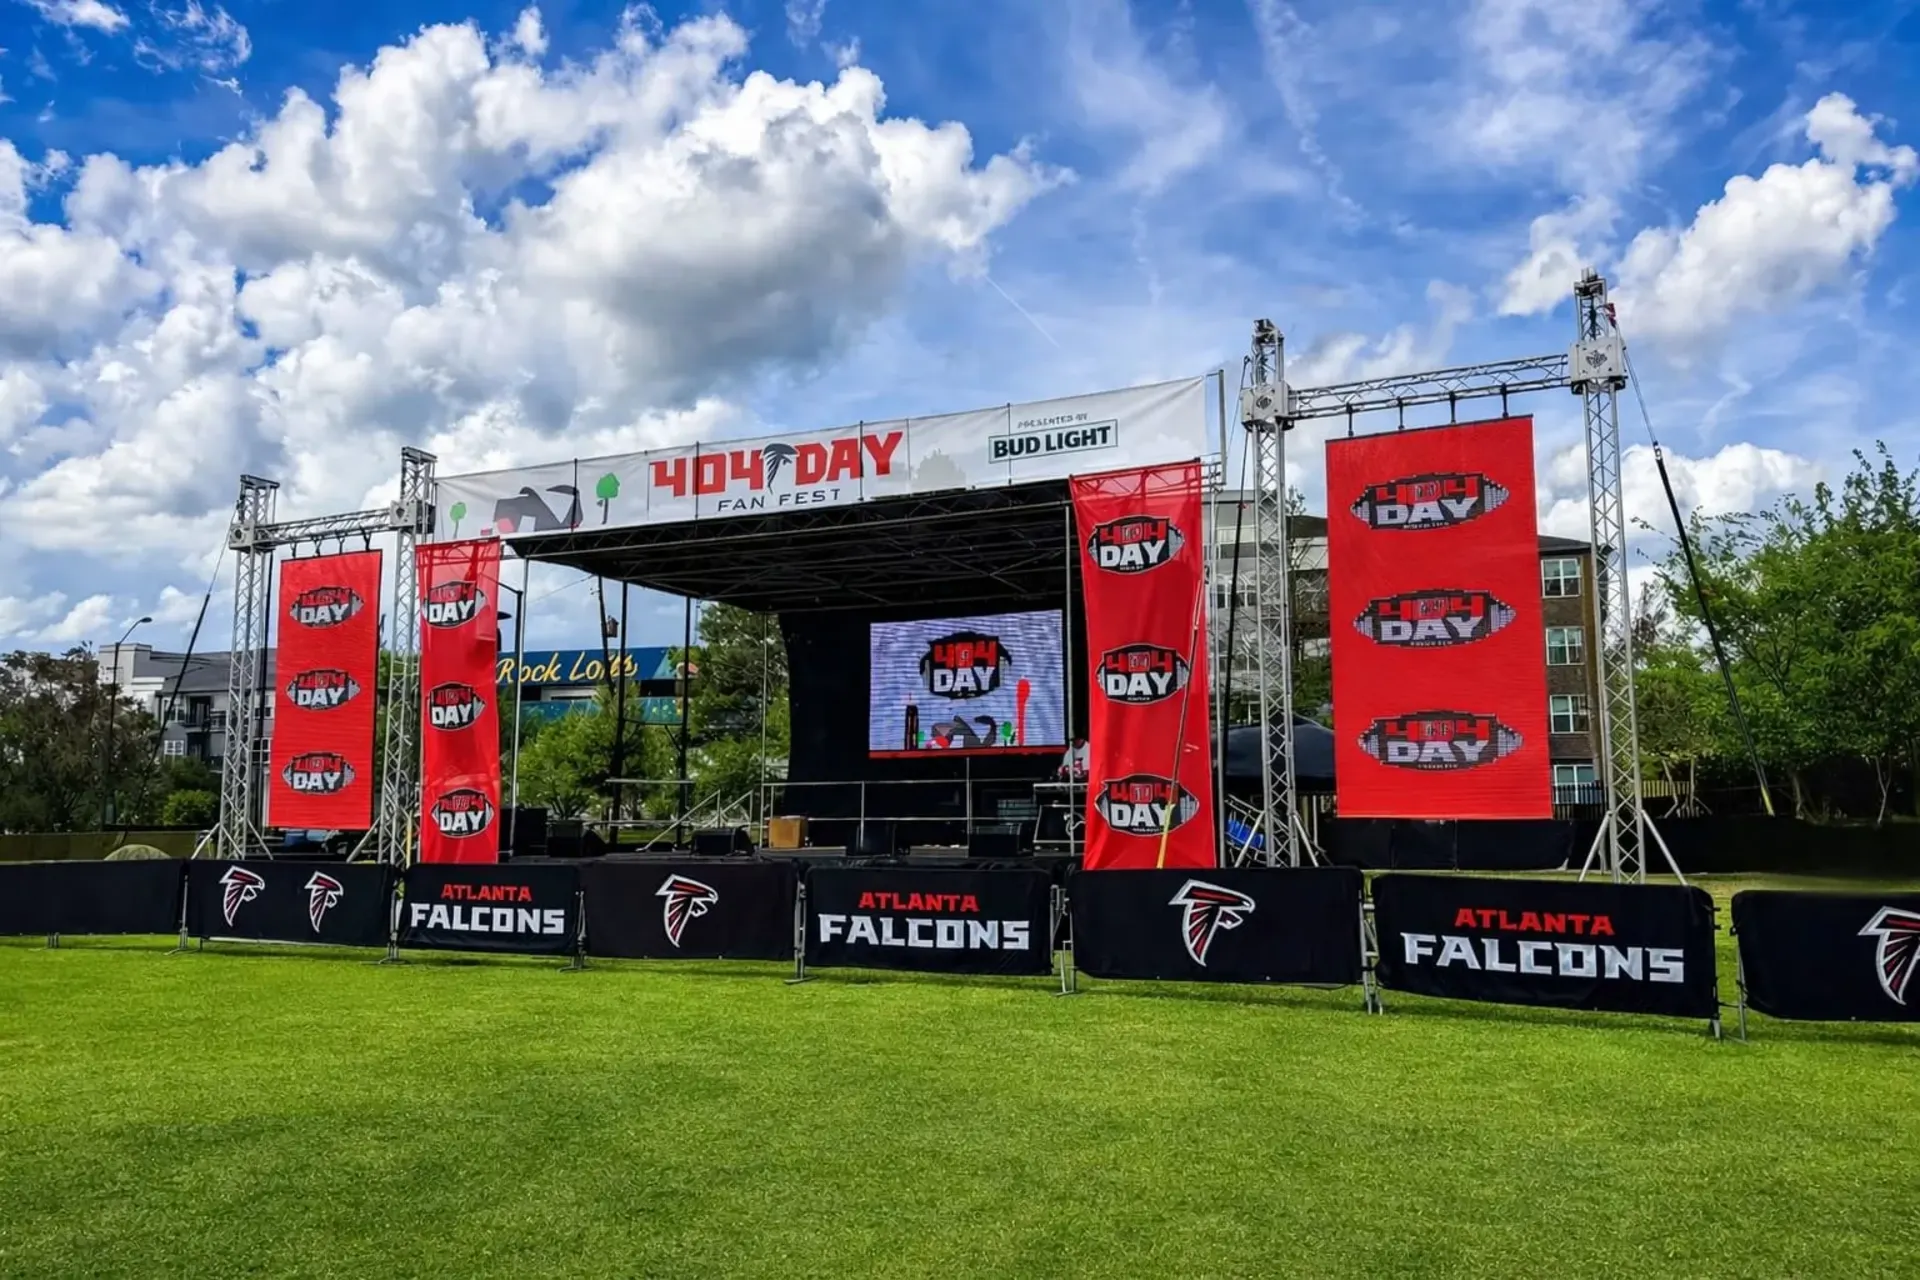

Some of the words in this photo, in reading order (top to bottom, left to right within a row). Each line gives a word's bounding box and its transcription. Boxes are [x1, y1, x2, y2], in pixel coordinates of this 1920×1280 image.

[993, 436, 1041, 459] BUD
[1045, 426, 1111, 452] LIGHT
[650, 449, 764, 497] 404
[794, 431, 904, 486] DAY
[717, 495, 766, 512] FAN
[778, 488, 841, 507] FEST
[1376, 497, 1478, 525] DAY
[1101, 540, 1165, 567] DAY
[300, 603, 350, 624] DAY
[429, 600, 474, 622] DAY
[1380, 616, 1483, 641] DAY
[934, 641, 998, 668] 404
[497, 653, 561, 683] Rock
[934, 667, 995, 692] DAY
[1107, 672, 1173, 696] DAY
[298, 687, 344, 706] DAY
[431, 704, 472, 726] DAY
[1387, 740, 1489, 762] DAY
[293, 772, 340, 790] DAY
[440, 810, 484, 831] DAY
[1111, 803, 1176, 827] DAY
[441, 884, 532, 902] ATLANTA
[858, 892, 980, 912] ATLANTA
[411, 903, 564, 934] FALCONS
[1455, 908, 1615, 936] ATLANTA
[818, 914, 1029, 949] FALCONS
[1400, 932, 1684, 983] FALCONS
